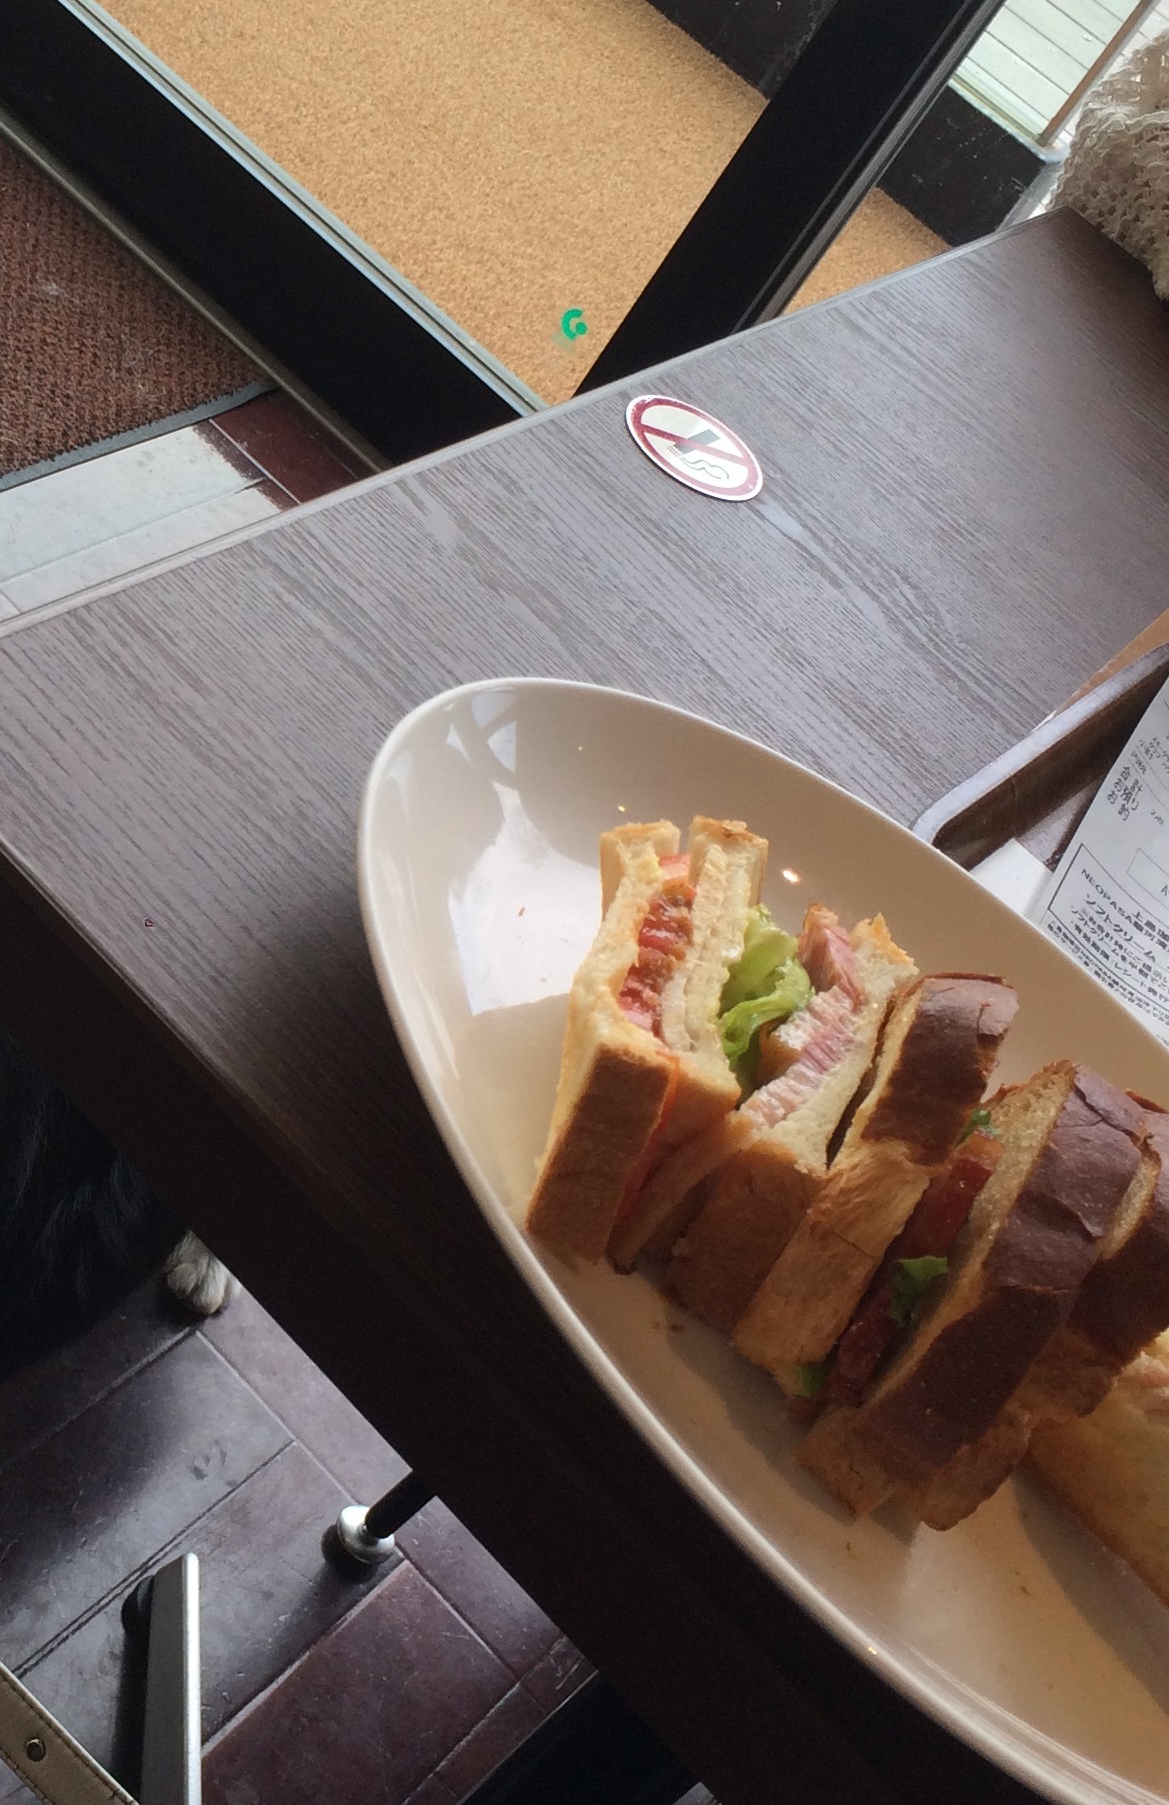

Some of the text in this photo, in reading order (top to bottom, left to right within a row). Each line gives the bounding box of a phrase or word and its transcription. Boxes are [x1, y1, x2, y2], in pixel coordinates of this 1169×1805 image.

[1114, 778, 1139, 811] お預り
[1085, 893, 1156, 963] ソフトクリーム
